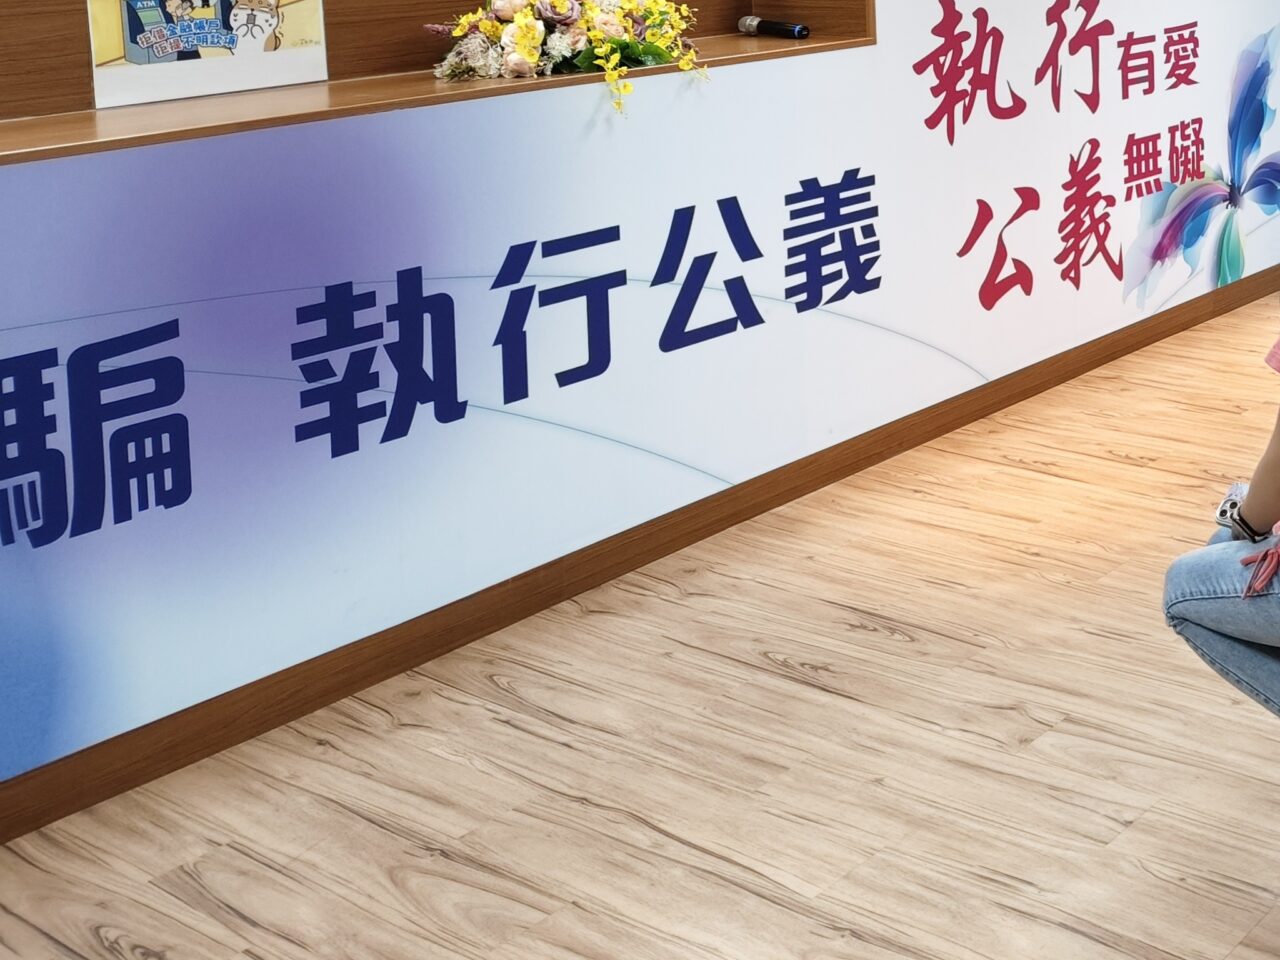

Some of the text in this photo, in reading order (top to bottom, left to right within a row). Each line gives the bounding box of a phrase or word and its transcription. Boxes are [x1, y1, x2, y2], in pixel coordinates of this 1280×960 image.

[136, 0, 156, 8] ATM
[138, 20, 220, 48] 拒借金融帳戶
[290, 167, 882, 459] 執行公義
